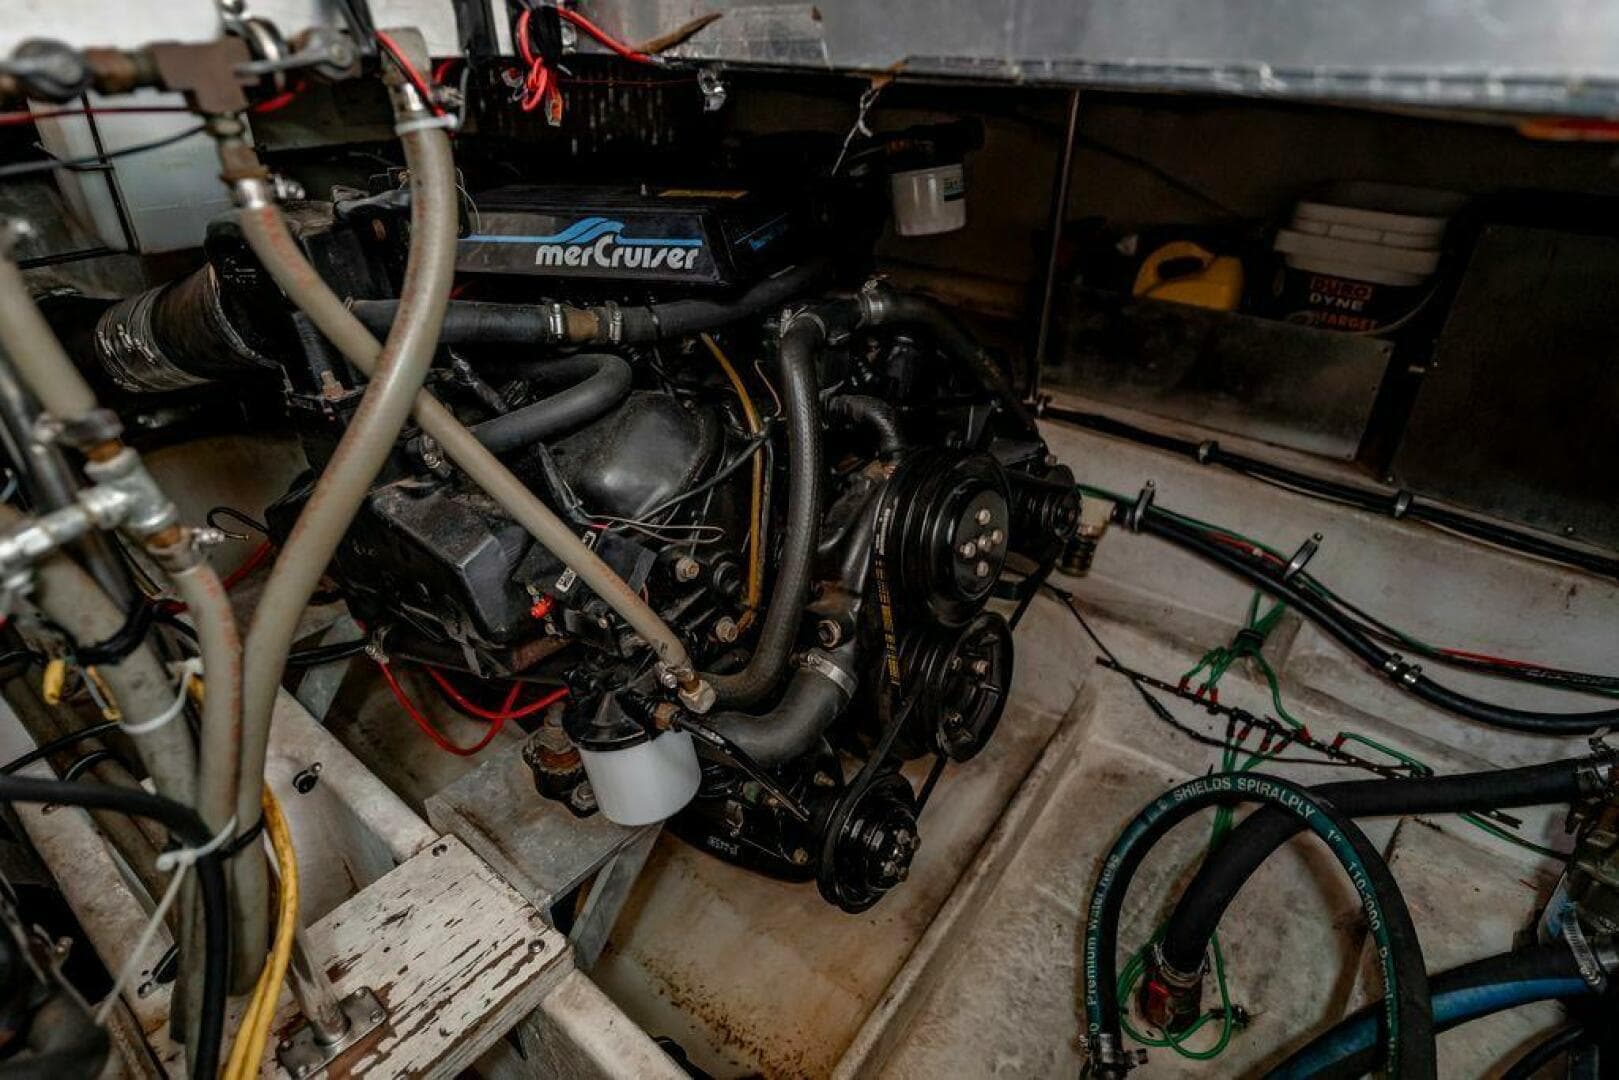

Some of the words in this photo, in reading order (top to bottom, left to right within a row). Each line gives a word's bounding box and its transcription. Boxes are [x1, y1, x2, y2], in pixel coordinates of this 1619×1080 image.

[1309, 291, 1366, 312] DYNE
[1084, 936, 1097, 1006] Premium
[1236, 776, 1317, 820] SPIRALPLY
[1348, 861, 1381, 932] 110-1000
